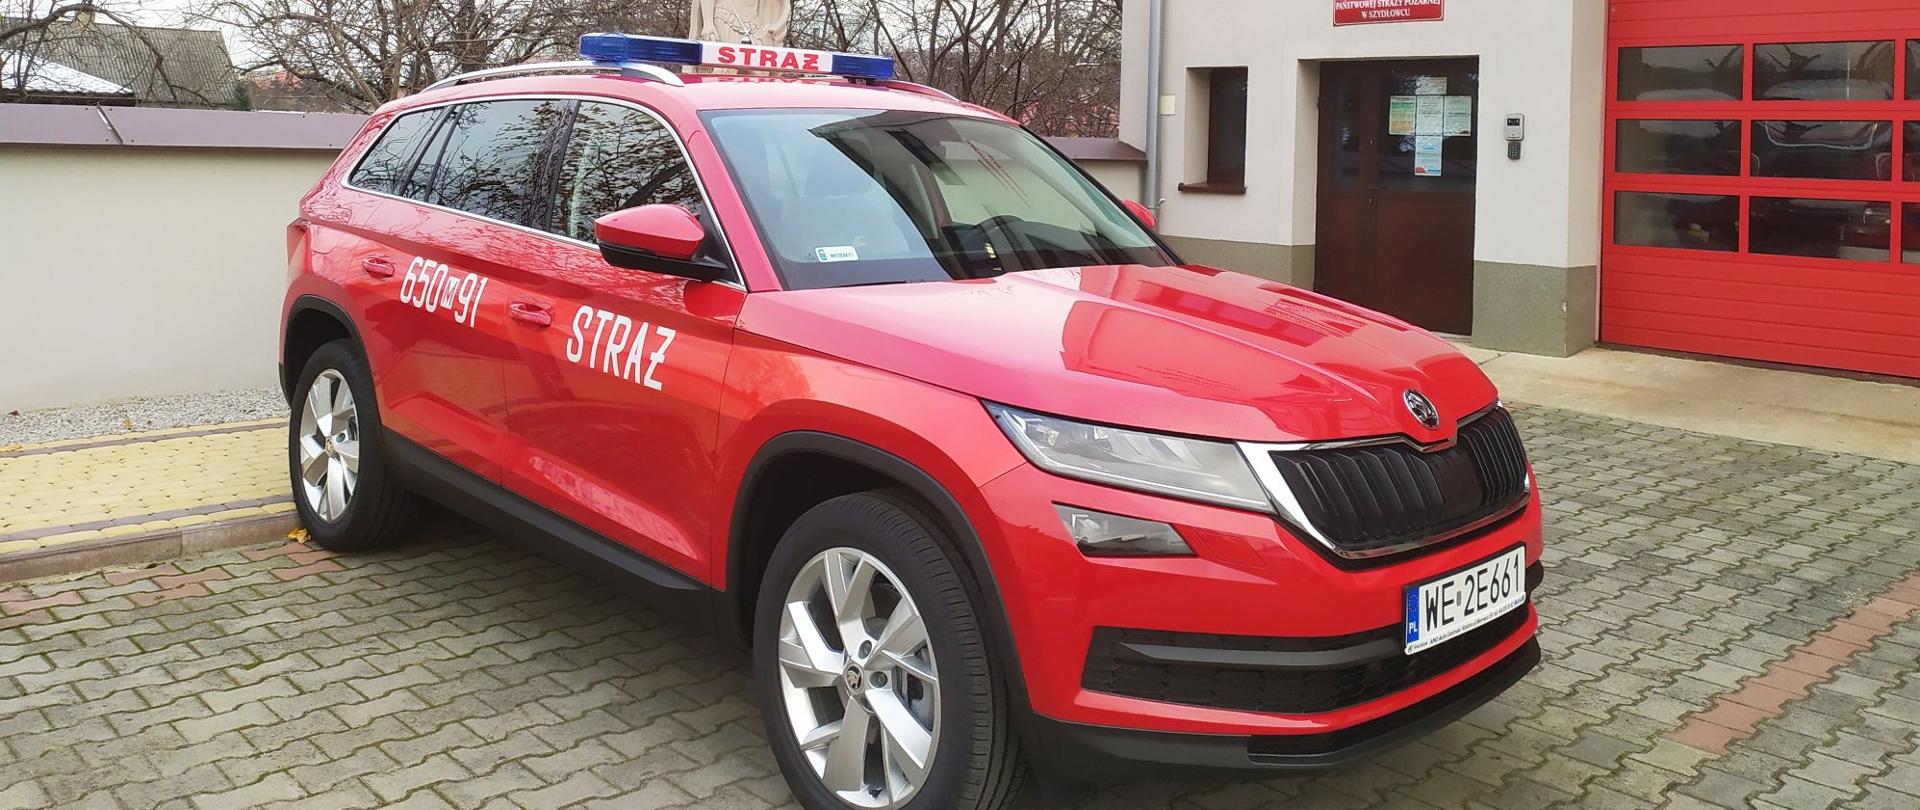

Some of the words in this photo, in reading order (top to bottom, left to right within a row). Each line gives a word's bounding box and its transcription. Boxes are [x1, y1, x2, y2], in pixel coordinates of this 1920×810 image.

[1361, 10, 1368, 18] W
[1368, 9, 1411, 18] SZYDŁOWCU
[1426, 580, 1455, 632] WE
[1464, 553, 1519, 616] 2E661
[1408, 620, 1418, 634] PL
